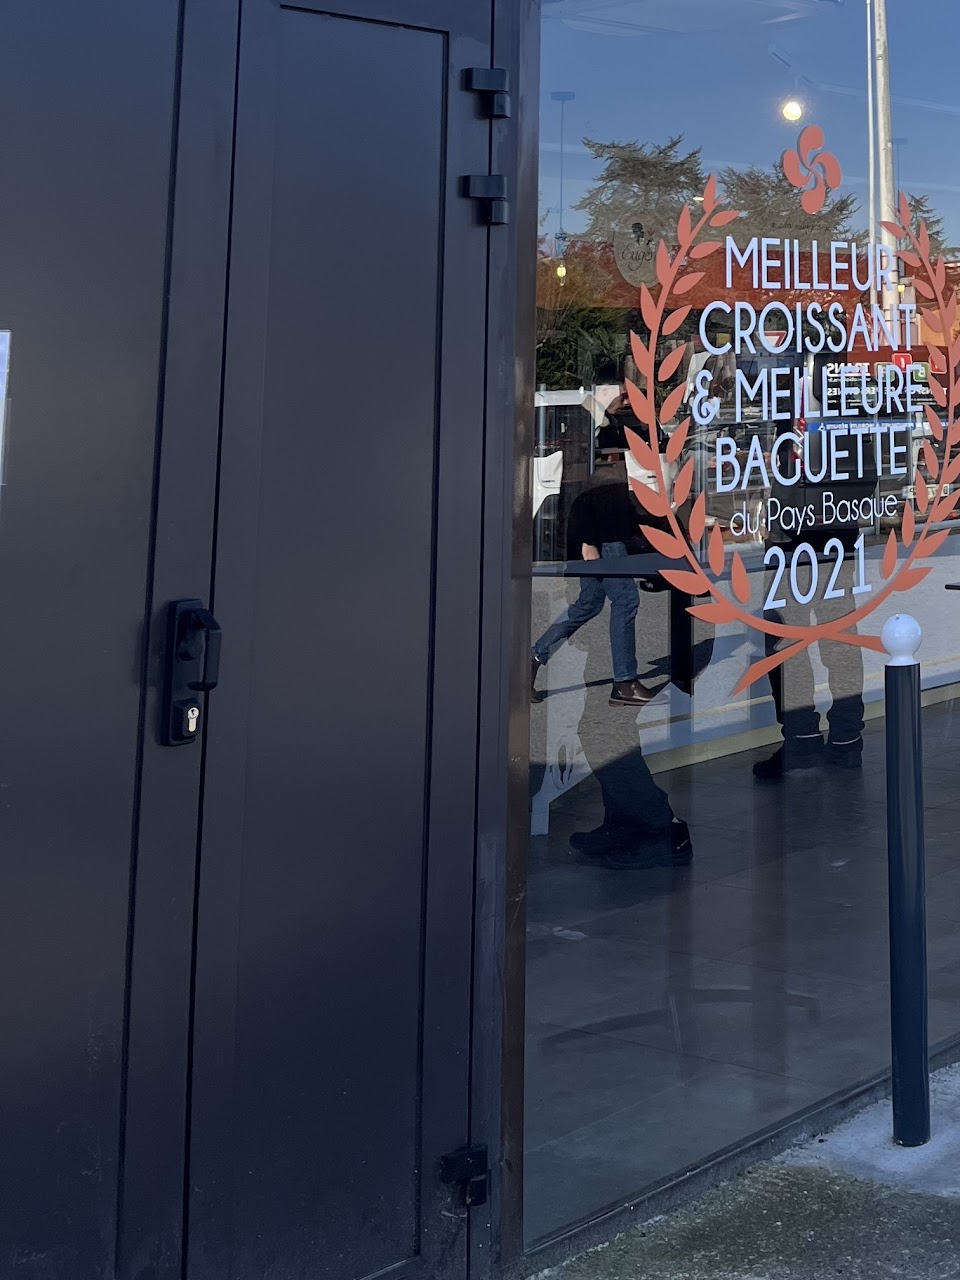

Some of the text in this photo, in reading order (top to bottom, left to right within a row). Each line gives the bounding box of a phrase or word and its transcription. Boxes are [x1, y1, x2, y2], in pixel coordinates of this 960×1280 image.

[726, 235, 895, 292] MEILLEUR
[699, 300, 916, 355] CROISSANT
[692, 369, 721, 426] &
[735, 363, 924, 423] MEILLEURE
[716, 426, 908, 493] BAGUETTE
[730, 491, 898, 537] du Pays Basque
[763, 532, 873, 611] 2021
